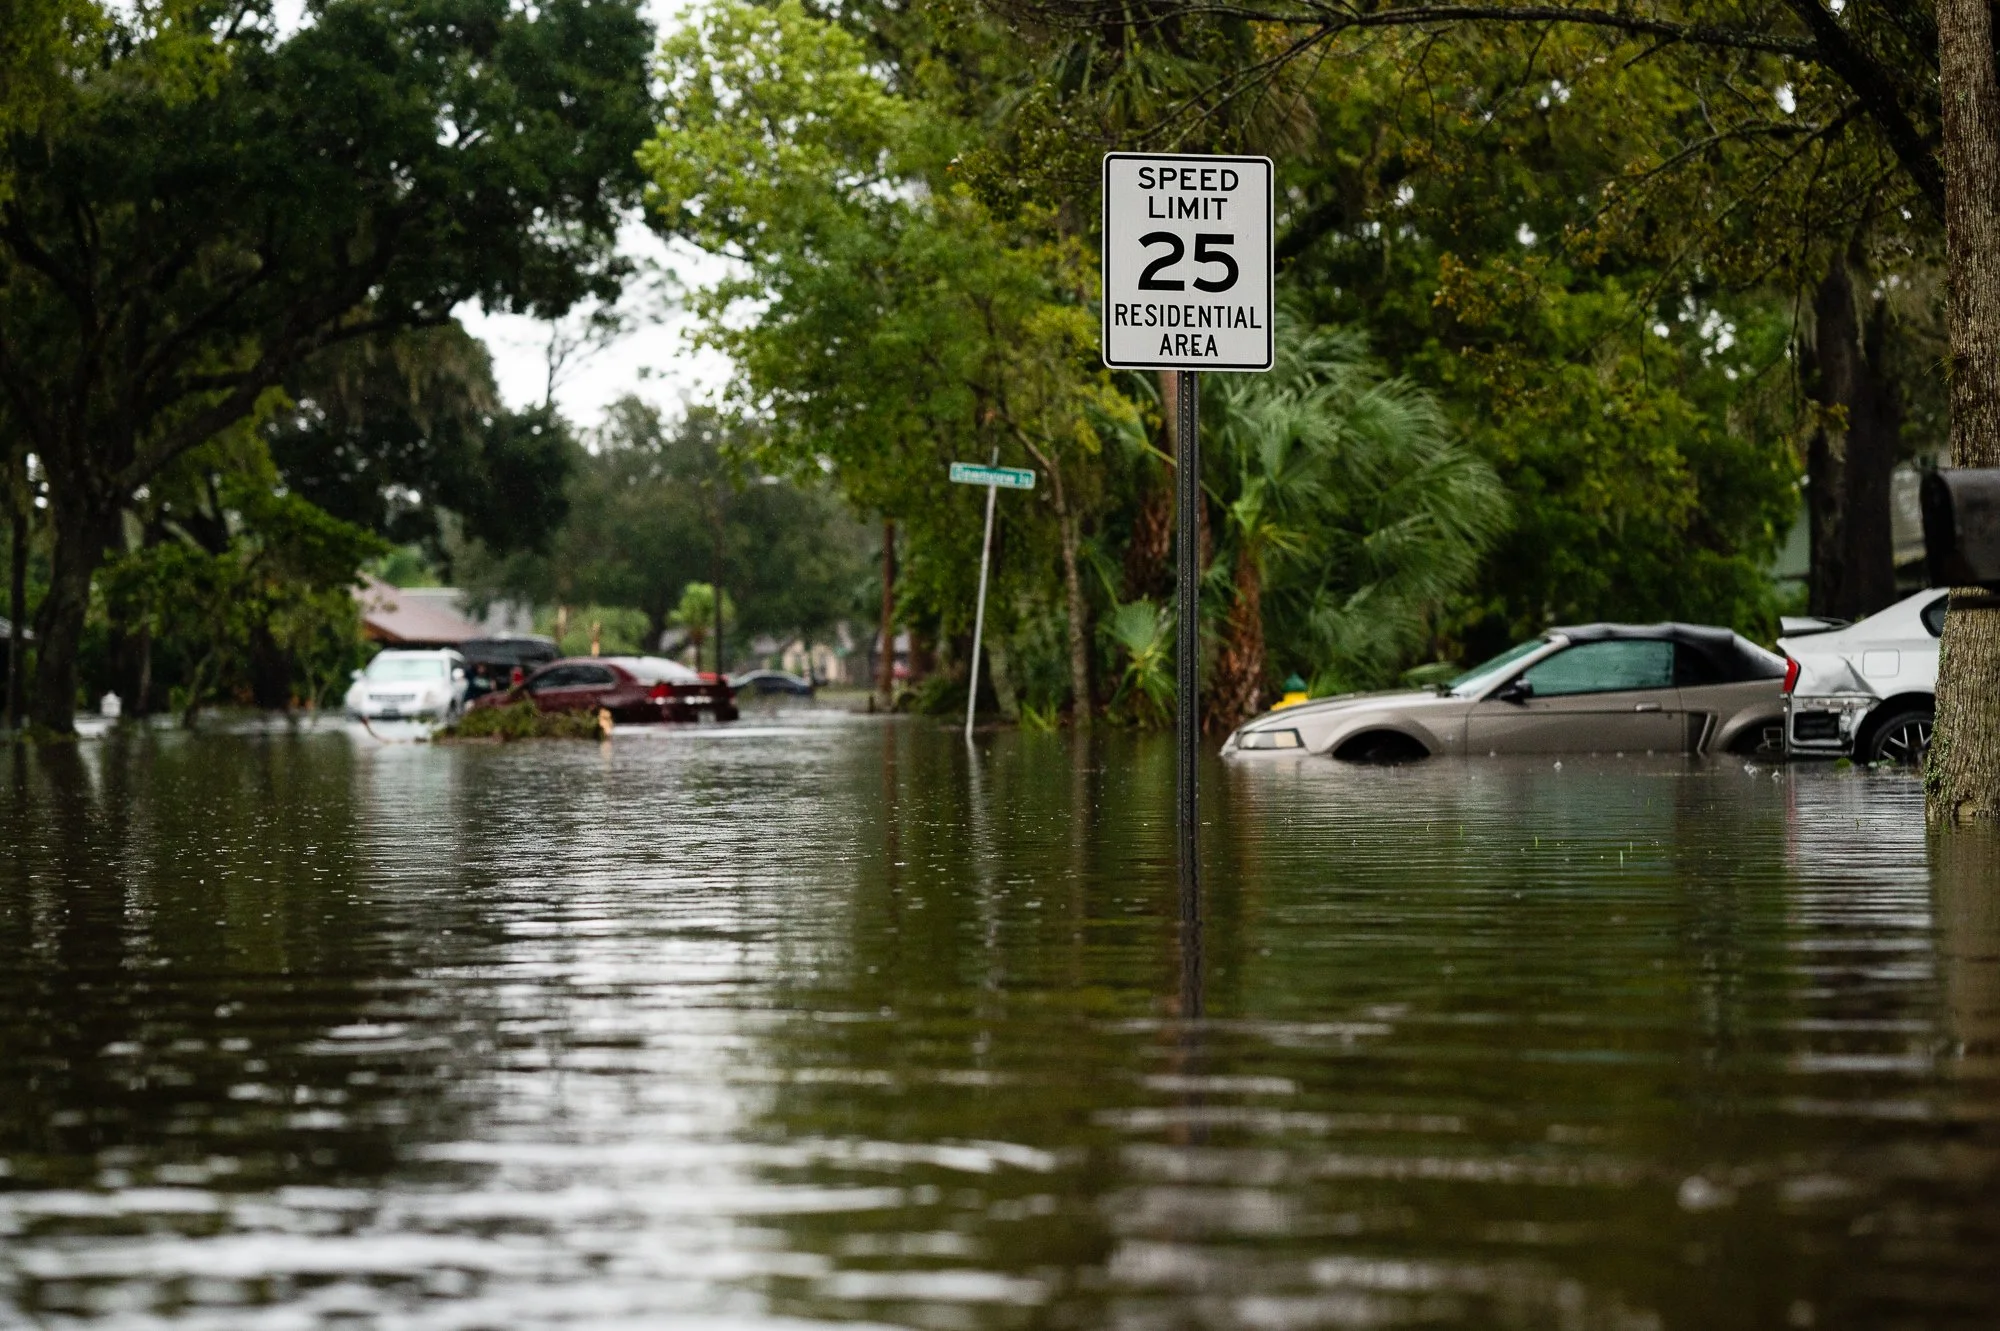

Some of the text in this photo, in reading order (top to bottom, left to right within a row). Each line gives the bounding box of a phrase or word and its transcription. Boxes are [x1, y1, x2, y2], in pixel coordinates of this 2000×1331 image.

[1138, 167, 1239, 191] SPEED
[1149, 196, 1228, 220] LIMIT
[1138, 231, 1239, 293] 25
[1115, 303, 1262, 329] RESIDENTIAL
[1159, 333, 1219, 357] AREA
